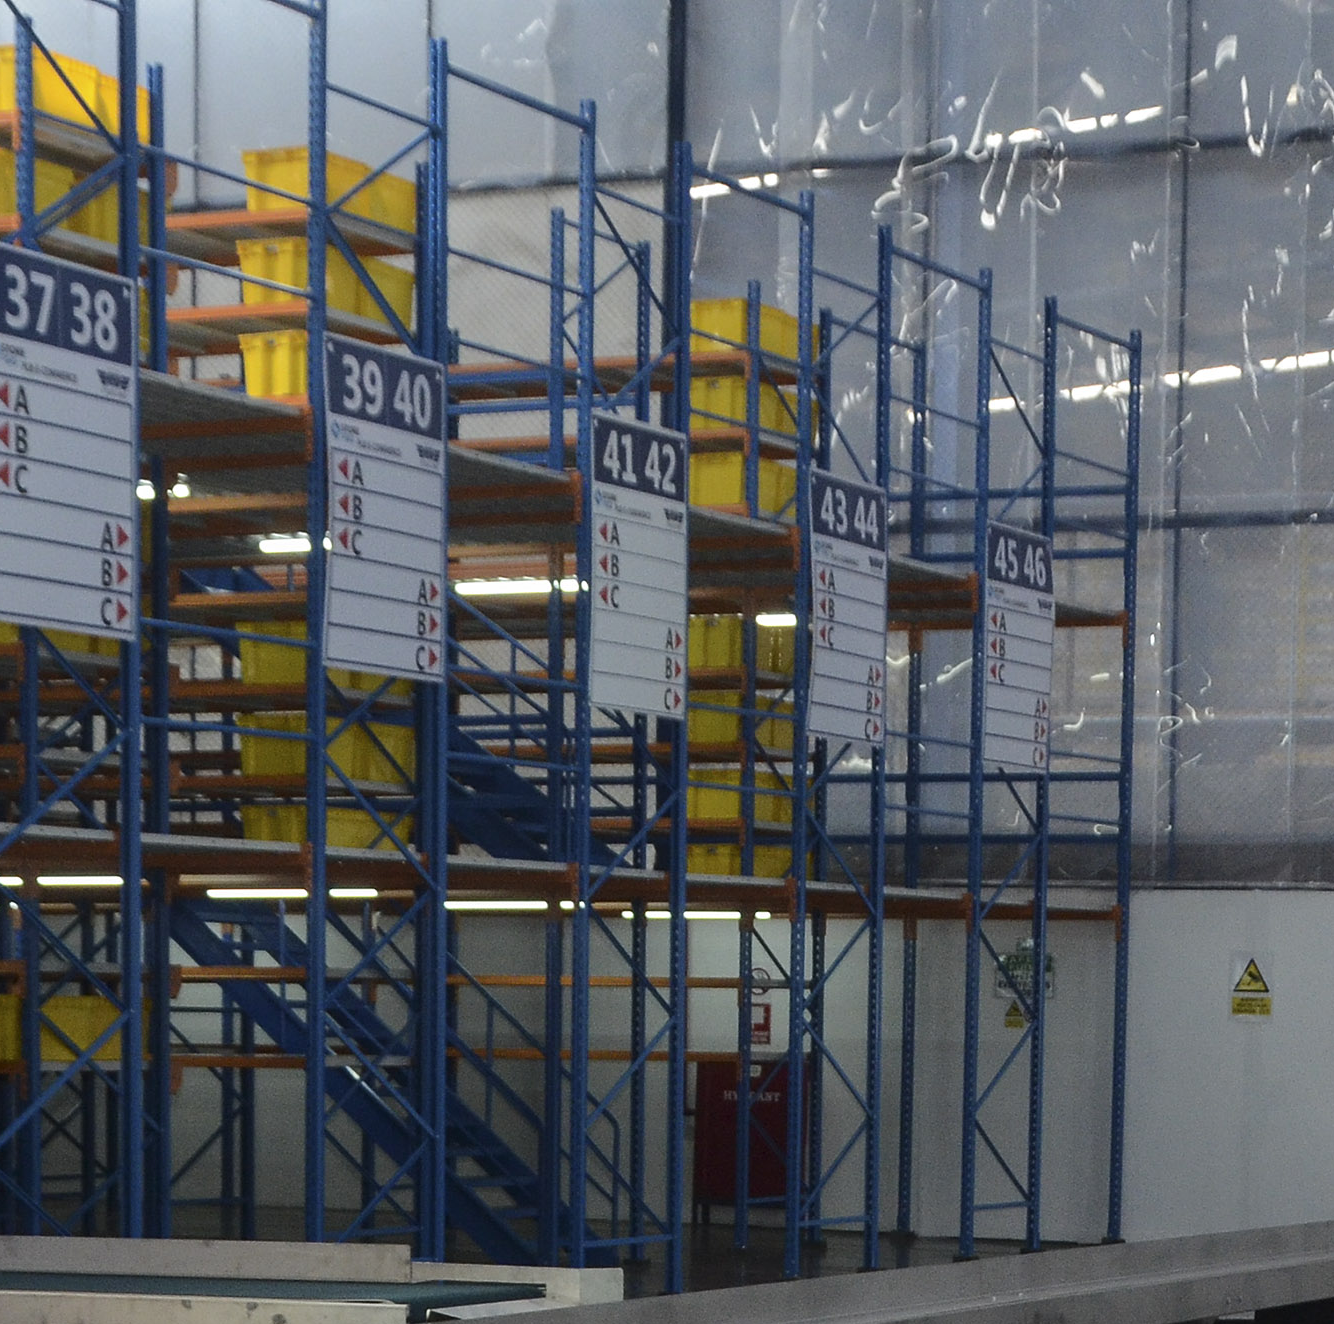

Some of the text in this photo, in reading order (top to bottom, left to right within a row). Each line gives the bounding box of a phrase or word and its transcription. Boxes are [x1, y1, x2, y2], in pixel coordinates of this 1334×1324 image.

[6, 265, 117, 352] 37 38
[14, 386, 29, 415] A
[343, 354, 431, 428] 39 40
[15, 425, 28, 454] B
[352, 461, 364, 485] A
[603, 430, 676, 494] 41 42
[14, 465, 28, 493] C
[353, 496, 362, 519] B
[821, 487, 878, 543] 43 44
[100, 523, 113, 550] A
[352, 531, 362, 555] C
[610, 522, 620, 546] A
[101, 560, 112, 586] B
[611, 554, 619, 577] B
[995, 537, 1046, 586] 45 46
[828, 569, 835, 591] A
[418, 580, 427, 604] A
[611, 585, 619, 608] C
[101, 600, 111, 626] C
[828, 599, 835, 618] B
[418, 613, 426, 635] B
[999, 614, 1006, 632] A
[666, 628, 673, 650] A
[827, 628, 834, 647] C
[999, 639, 1005, 657] B
[416, 647, 425, 670] C
[665, 657, 672, 679] B
[868, 666, 874, 684] A
[998, 664, 1005, 682] C
[664, 688, 671, 710] C
[867, 692, 873, 710] B
[1035, 699, 1041, 717] A
[865, 719, 871, 738] C
[1034, 723, 1040, 741] B
[1033, 747, 1038, 764] C
[724, 1090, 780, 1101] HYANT
